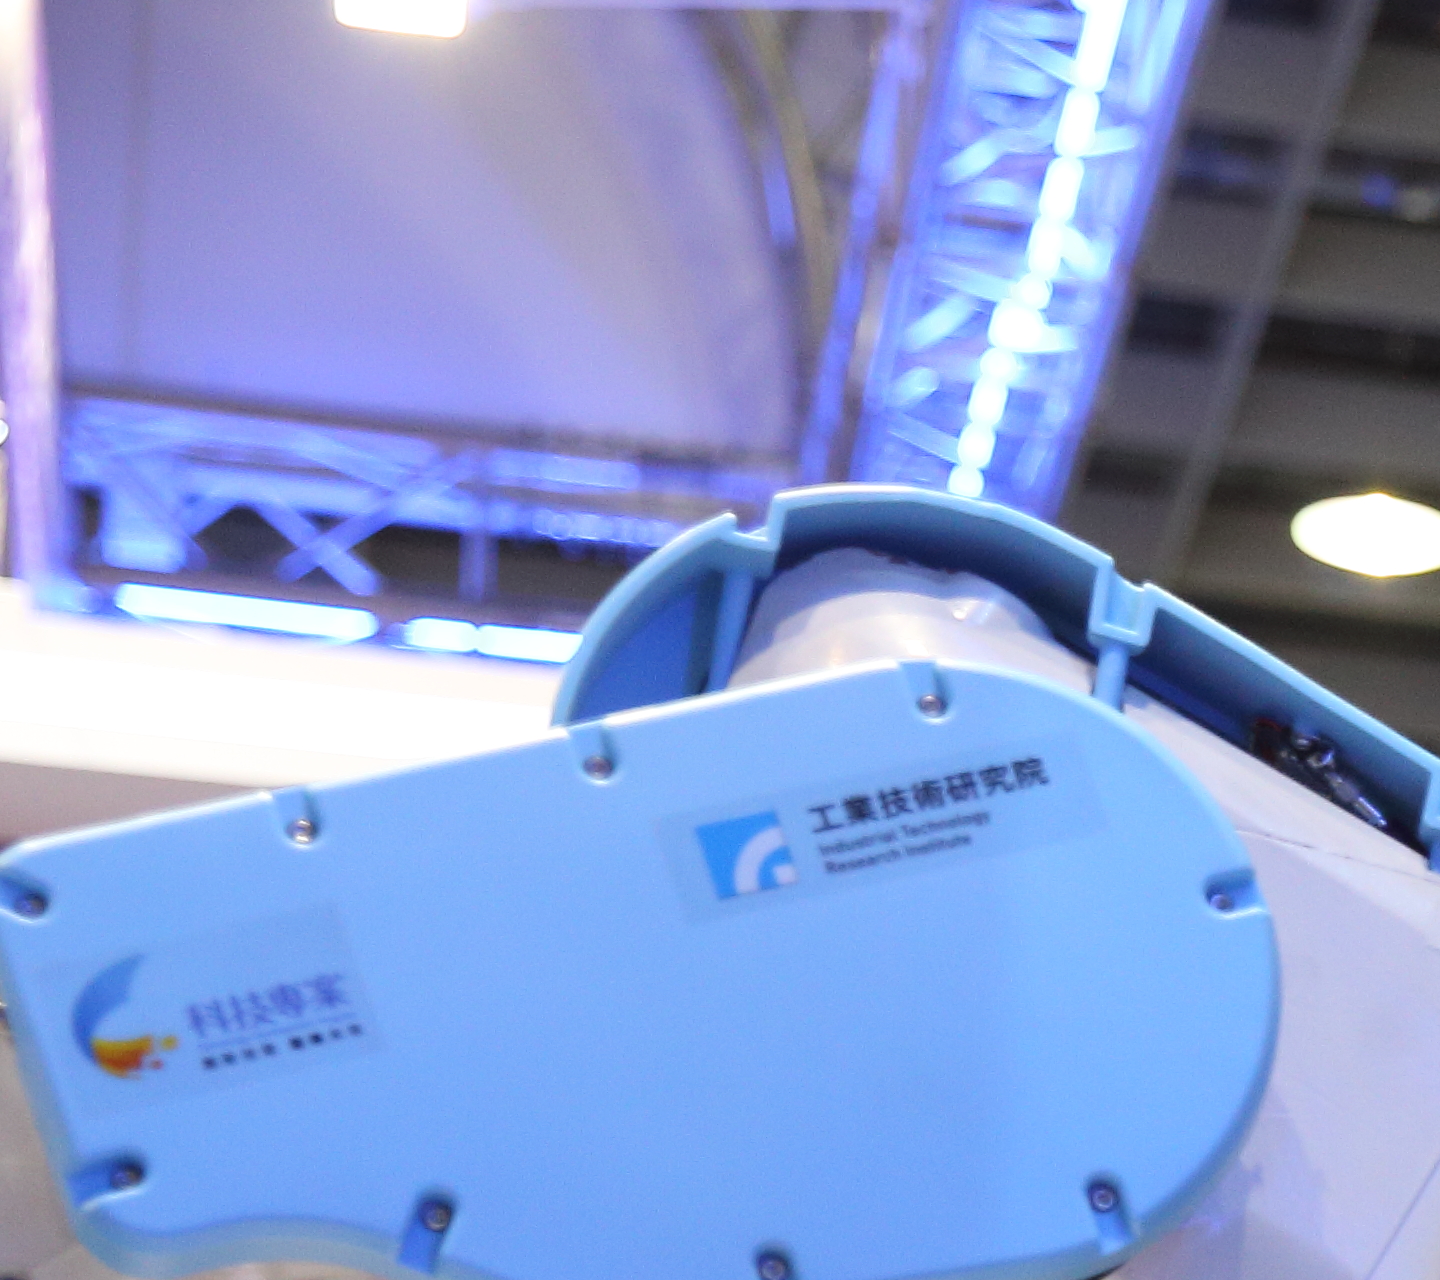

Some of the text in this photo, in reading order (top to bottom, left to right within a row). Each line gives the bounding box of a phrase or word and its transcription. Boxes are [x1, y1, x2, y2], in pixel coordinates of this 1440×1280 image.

[808, 757, 1049, 833] 工業技術研究院
[901, 811, 991, 837] Technology
[825, 849, 900, 874] Research
